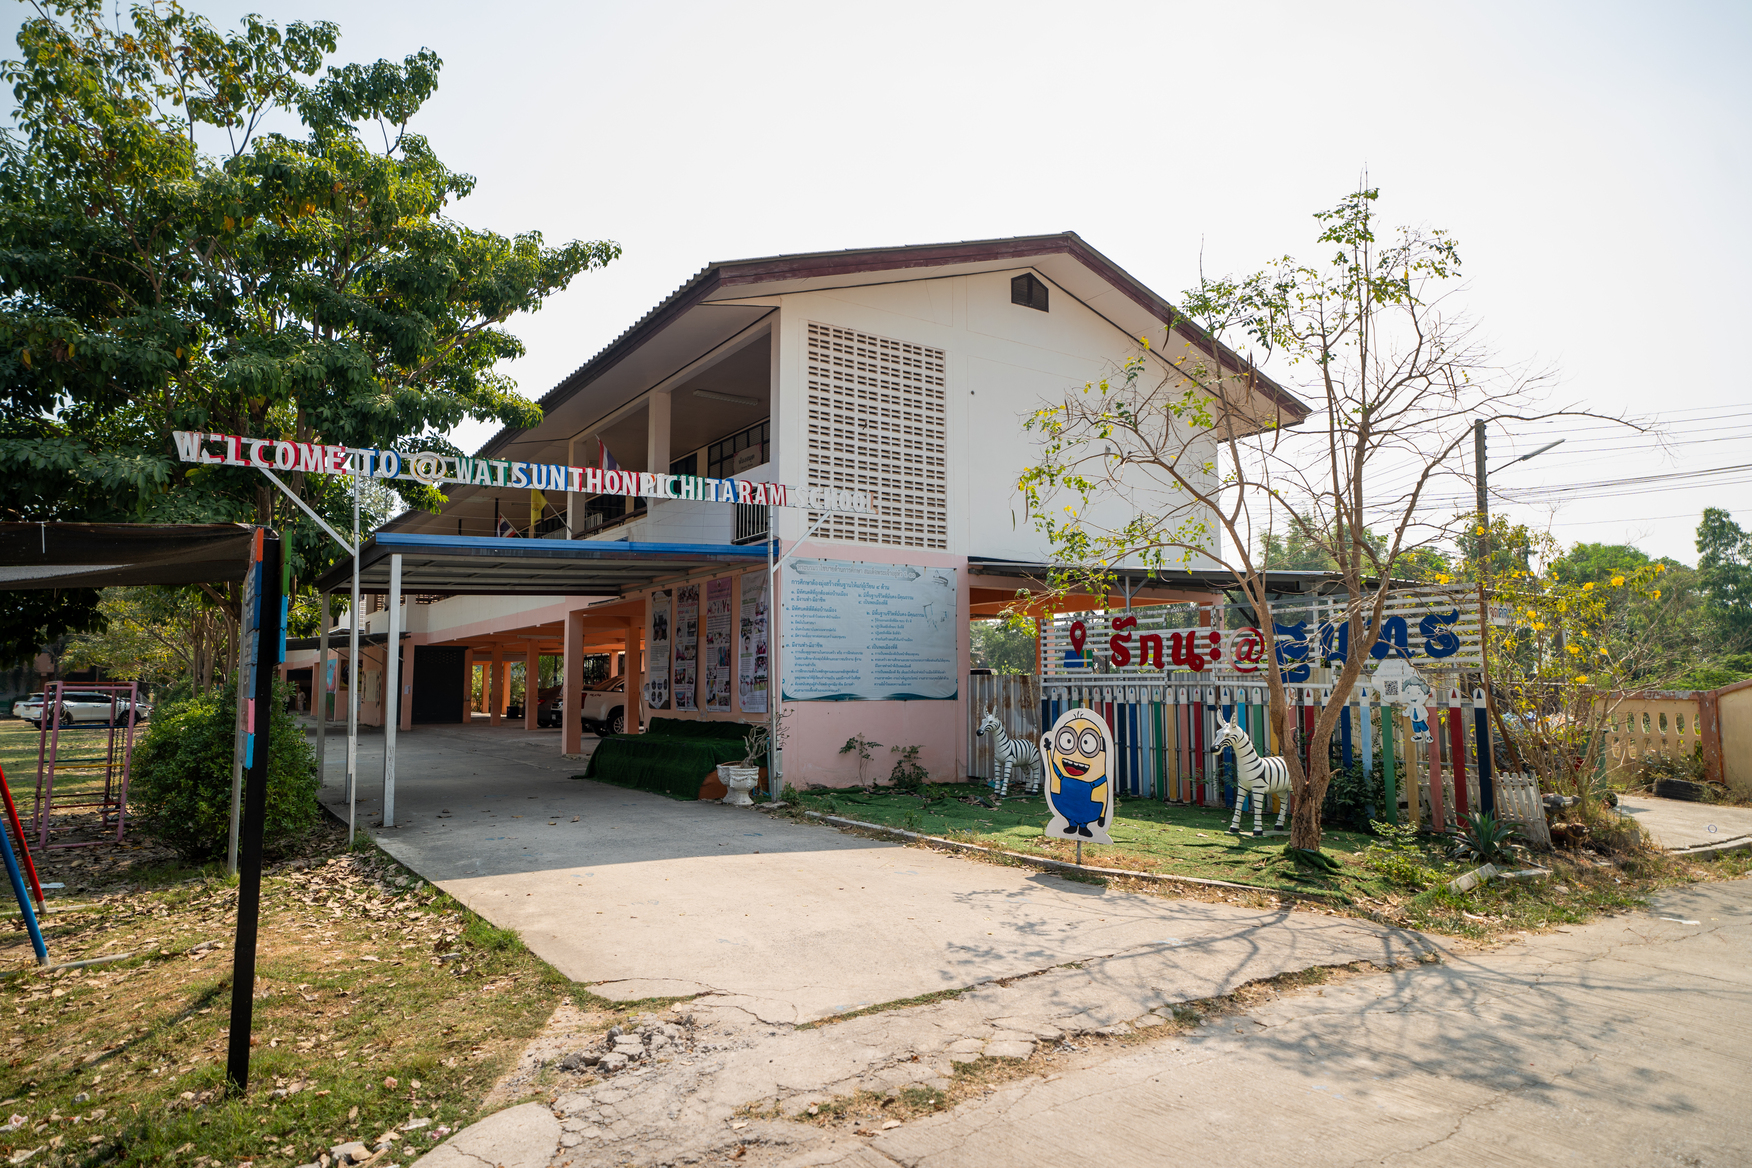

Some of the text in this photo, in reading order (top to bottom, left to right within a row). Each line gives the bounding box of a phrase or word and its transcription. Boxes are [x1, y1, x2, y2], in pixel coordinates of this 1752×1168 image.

[359, 448, 401, 479] TO
[410, 451, 447, 485] @
[794, 486, 879, 514] SCHOOL
